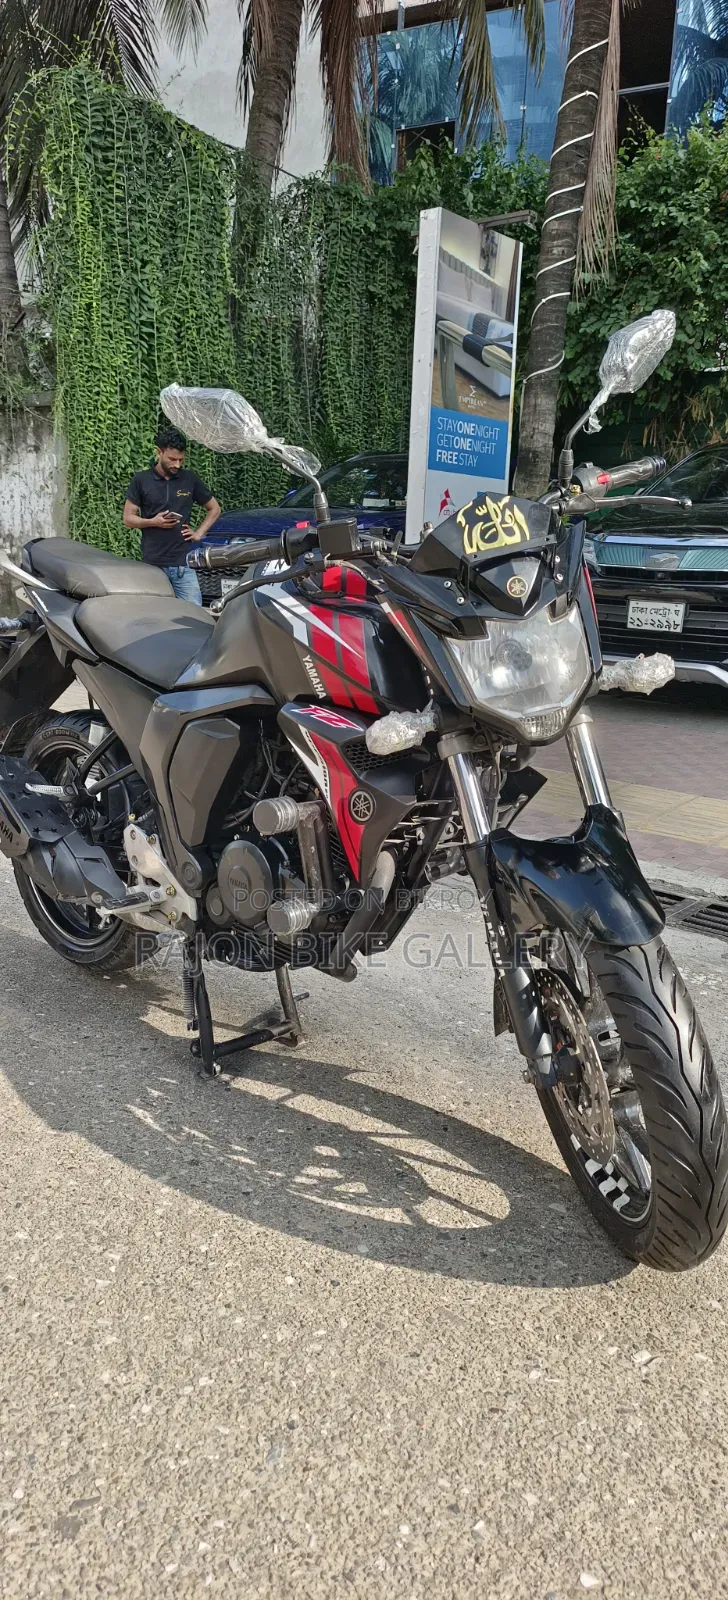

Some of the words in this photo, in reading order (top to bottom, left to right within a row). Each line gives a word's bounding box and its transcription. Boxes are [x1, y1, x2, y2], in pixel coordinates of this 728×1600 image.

[436, 449, 458, 465] FREE
[458, 452, 478, 467] STAY
[302, 654, 327, 699] YAMAHA
